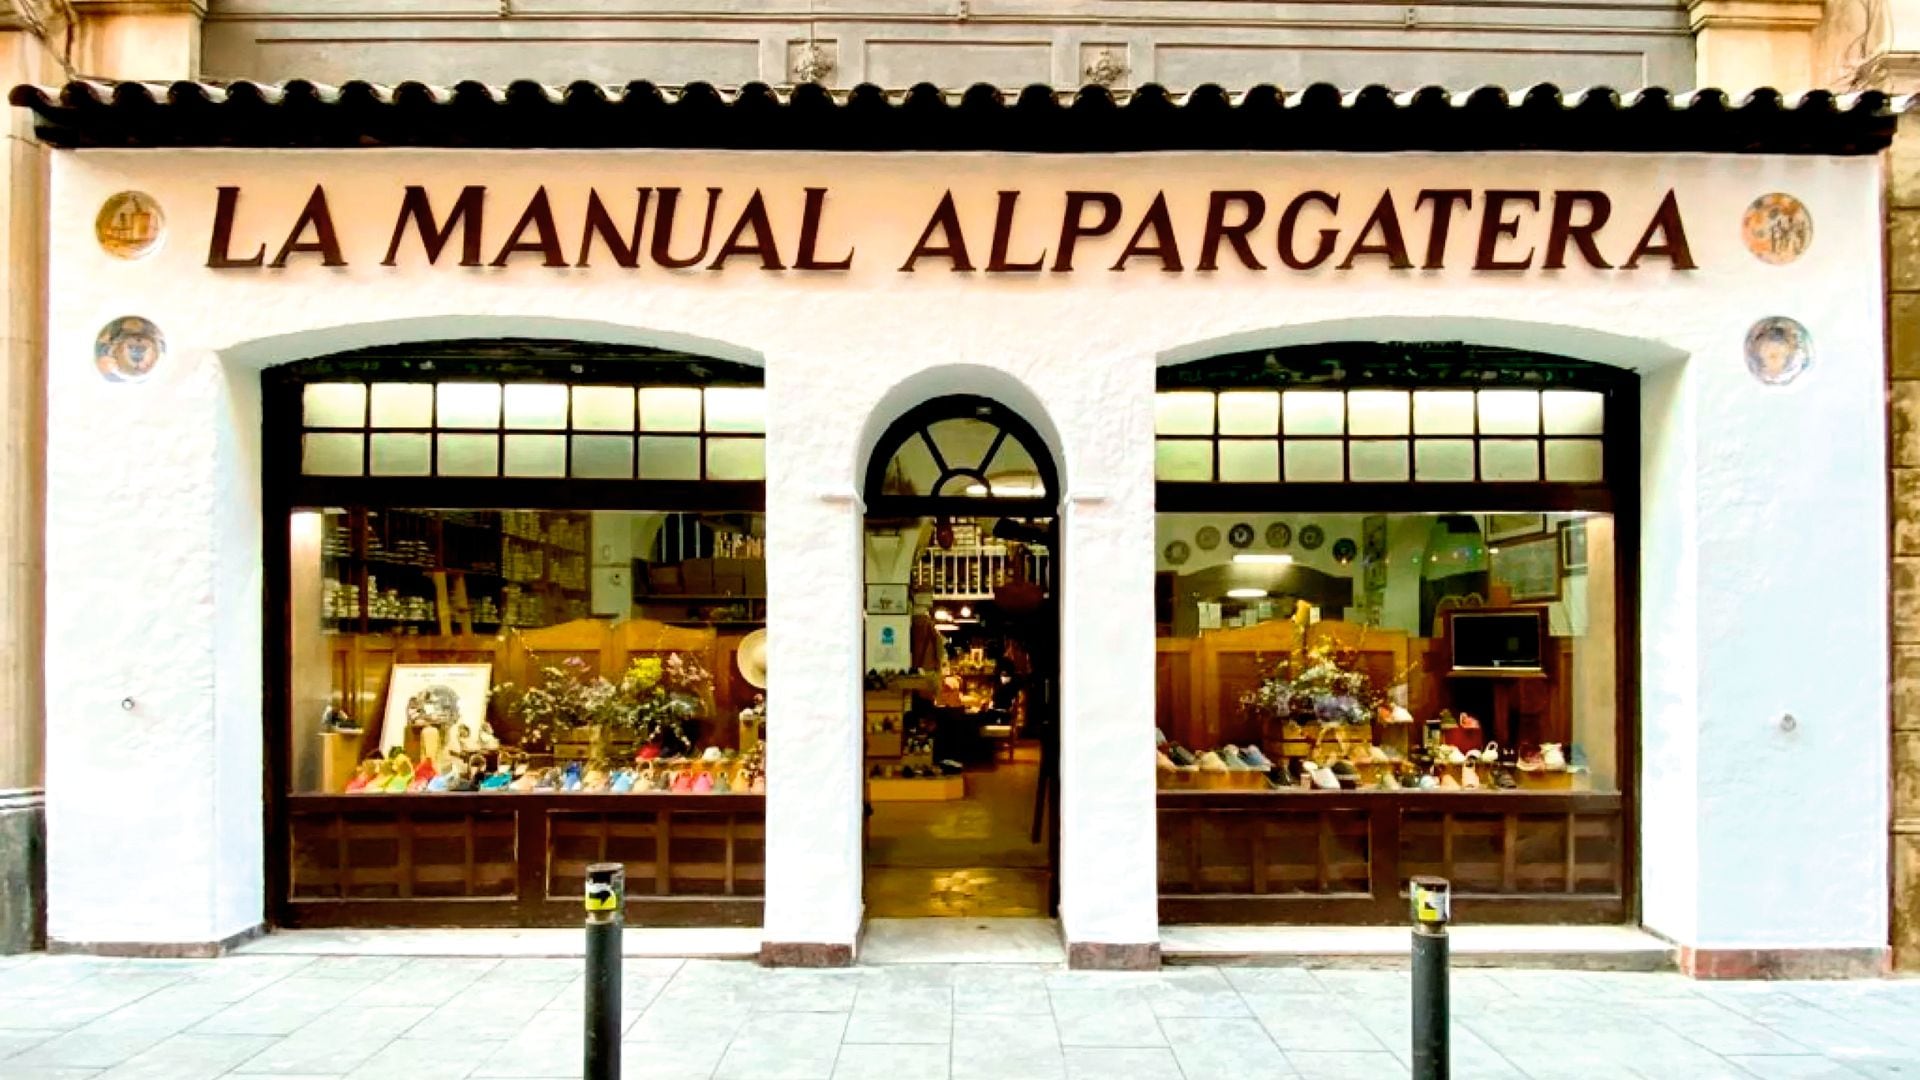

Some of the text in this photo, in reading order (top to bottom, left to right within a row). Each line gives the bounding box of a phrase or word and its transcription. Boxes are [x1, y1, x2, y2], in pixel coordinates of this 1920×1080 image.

[207, 184, 1698, 273] LA MANUAL ALPARGATERA
